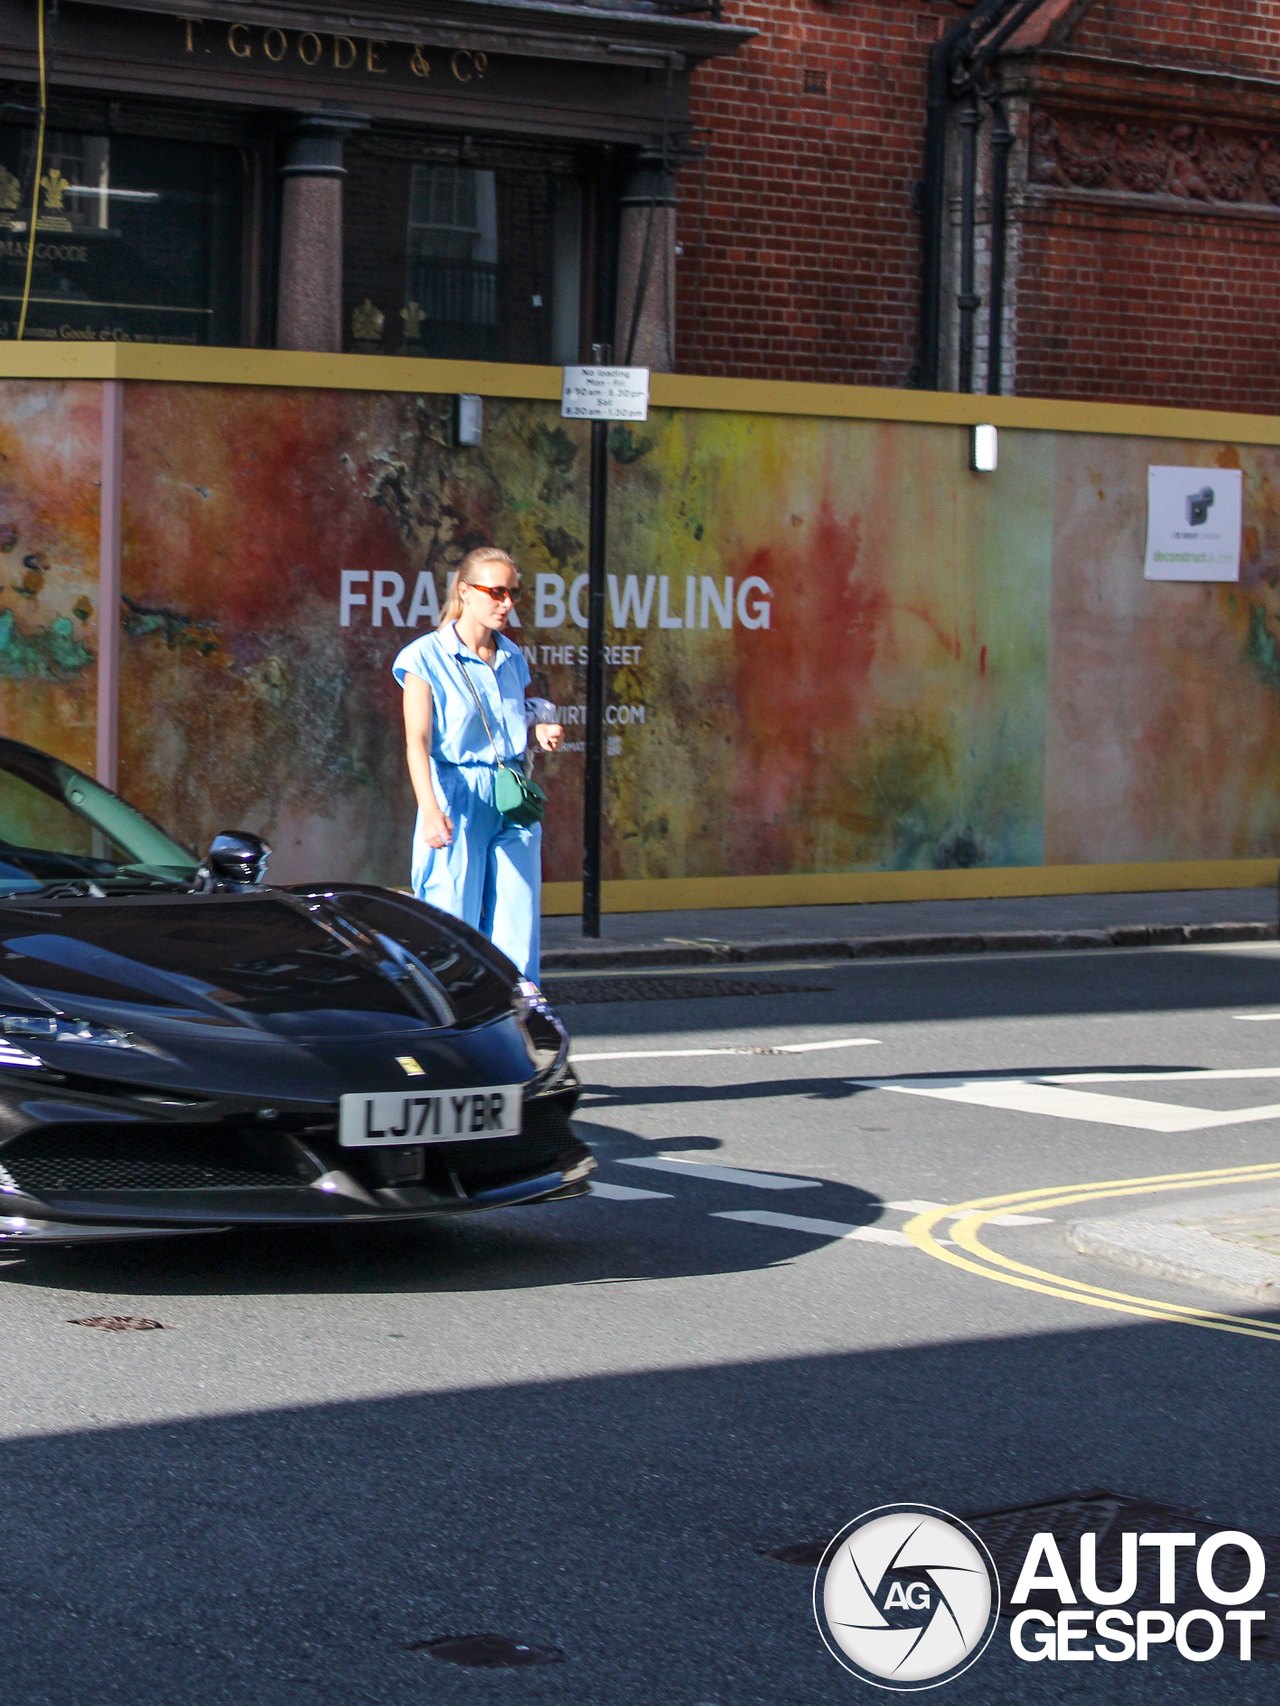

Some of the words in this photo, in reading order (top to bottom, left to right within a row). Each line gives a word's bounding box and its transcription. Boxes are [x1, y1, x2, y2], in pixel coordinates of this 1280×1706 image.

[227, 23, 389, 74] GOODE
[410, 43, 431, 79] &
[581, 368, 595, 378] No
[539, 645, 575, 666] THE
[364, 1097, 442, 1139] LJ71
[449, 1092, 505, 1134] YBR
